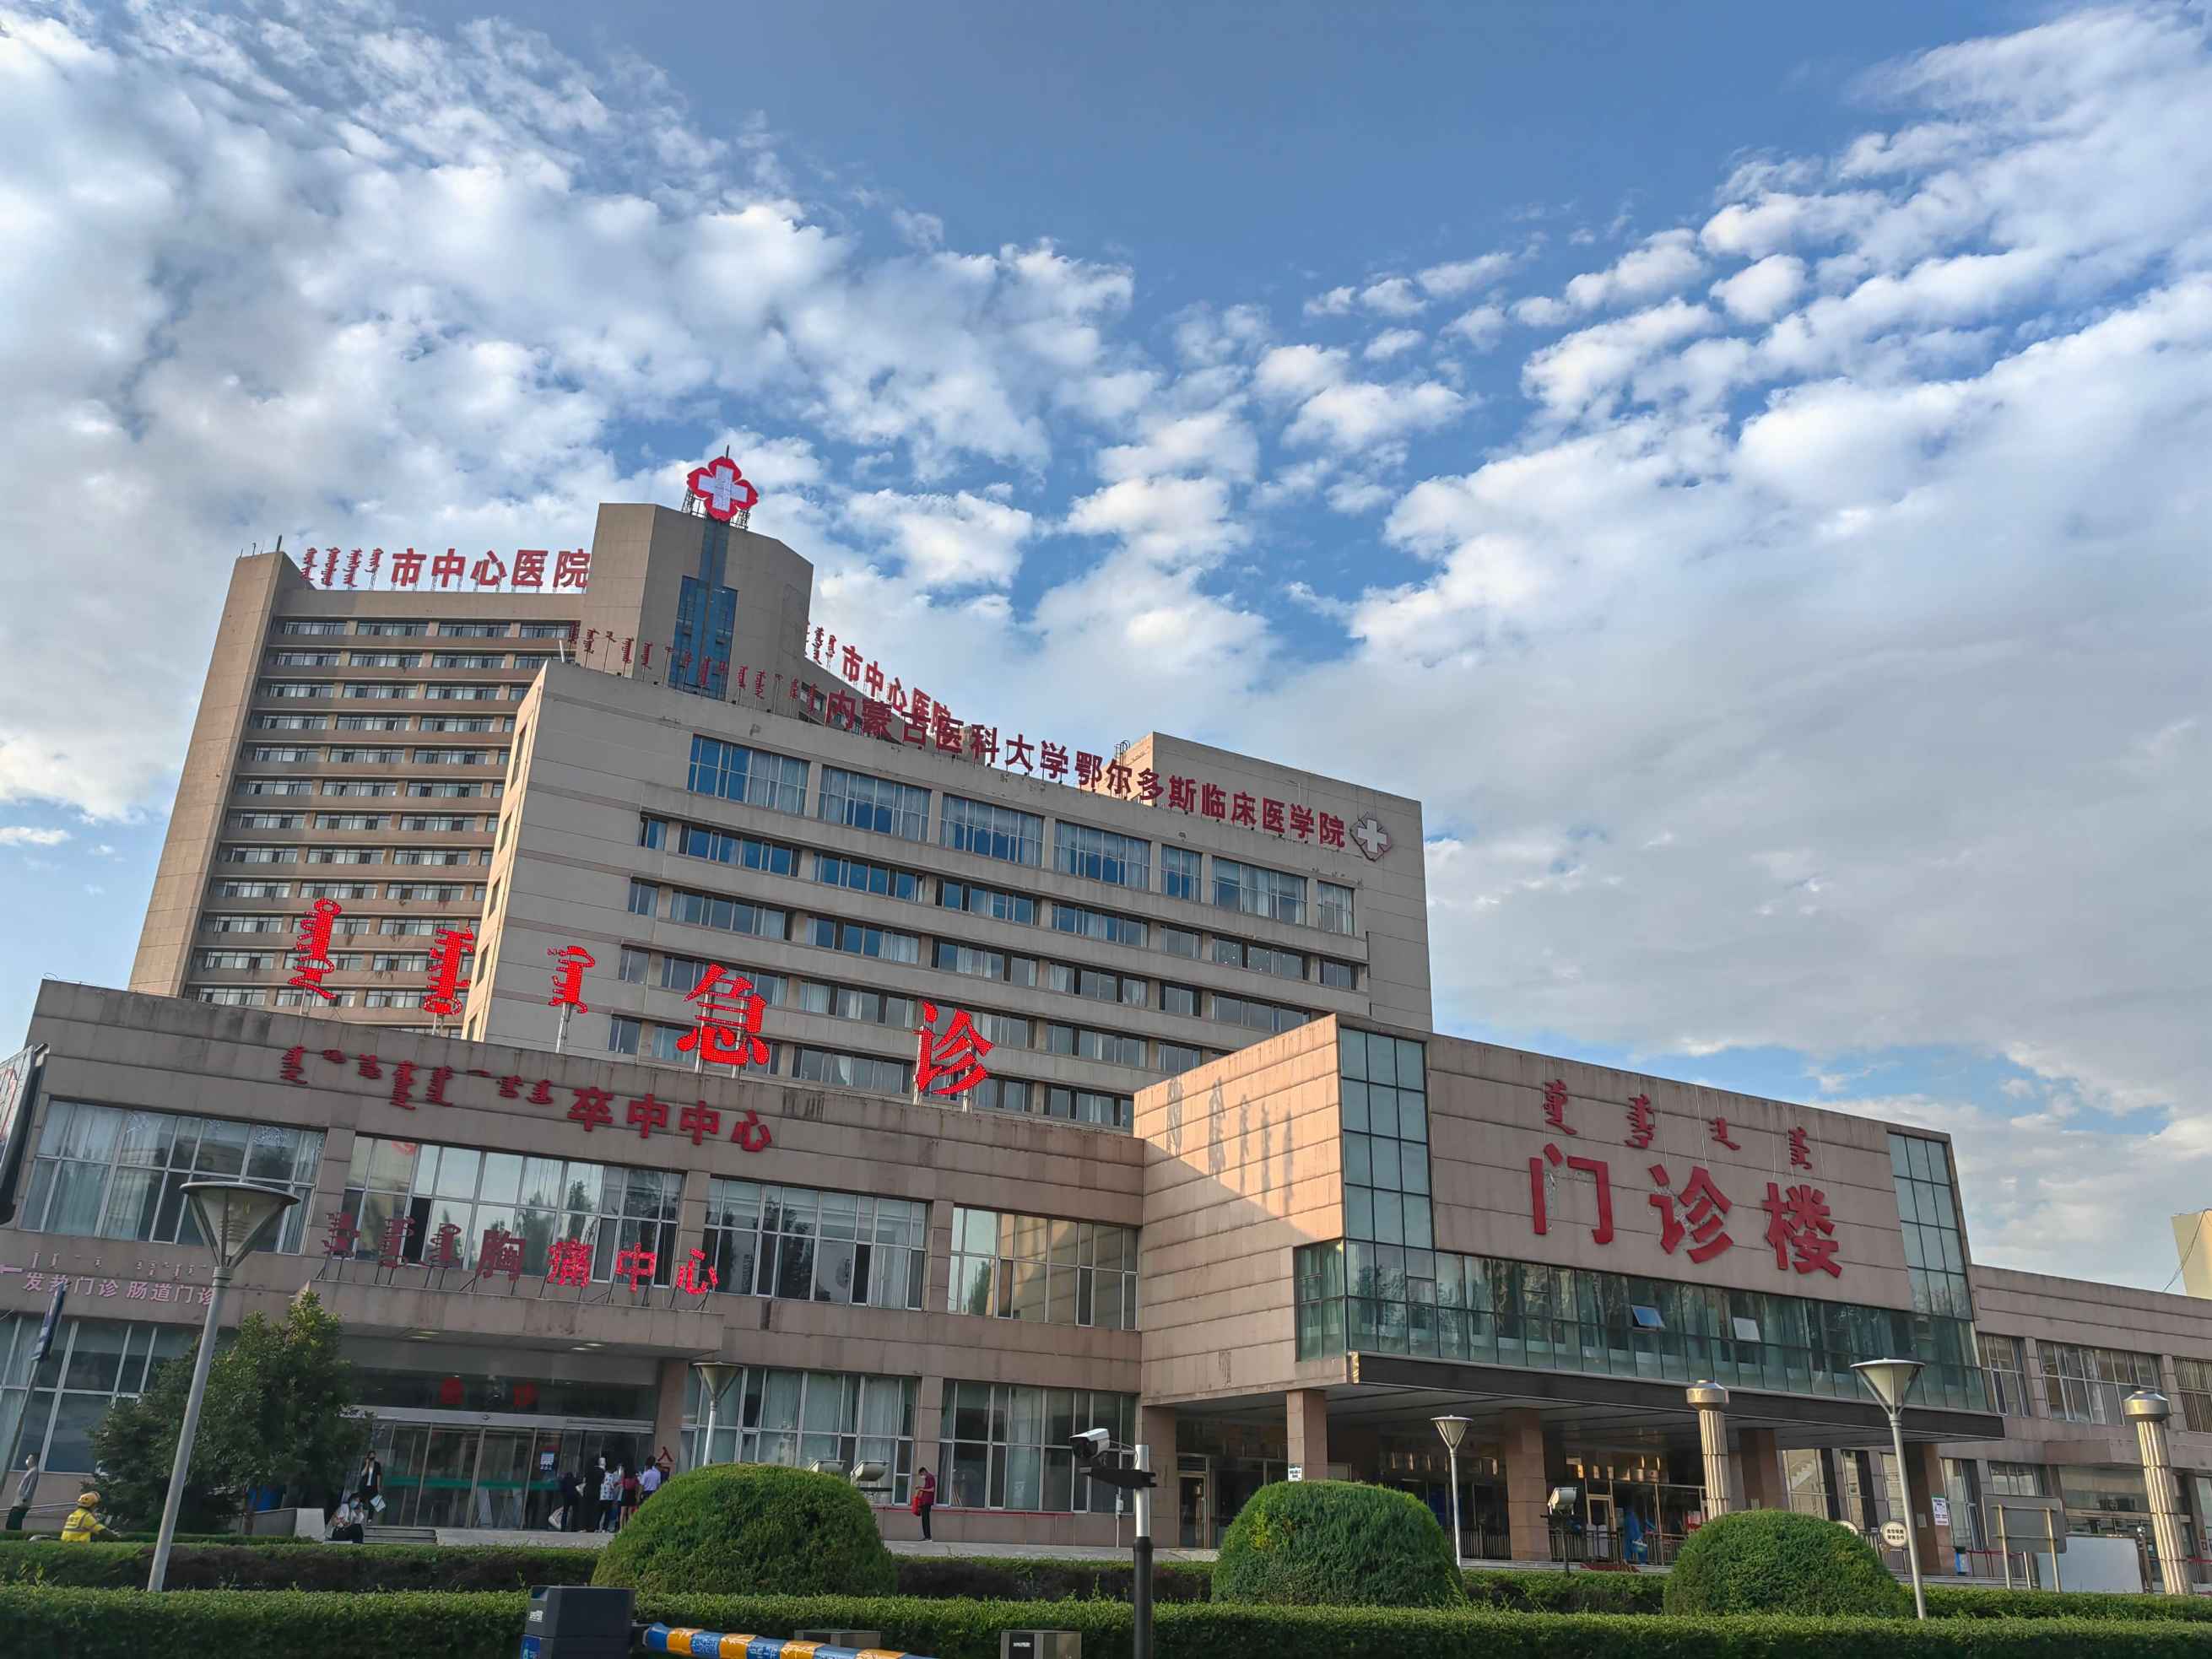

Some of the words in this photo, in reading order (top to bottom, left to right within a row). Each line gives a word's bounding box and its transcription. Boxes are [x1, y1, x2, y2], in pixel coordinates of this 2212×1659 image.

[391, 548, 591, 588] 市中心医院
[824, 689, 1346, 848] 内蒙古医科大学鄂尔多斯临床医学院
[676, 964, 996, 1094] 急诊
[567, 1086, 771, 1153] 卒中中心
[1529, 1142, 1843, 1278] 门诊楼
[477, 1229, 719, 1295] 胸痛中心
